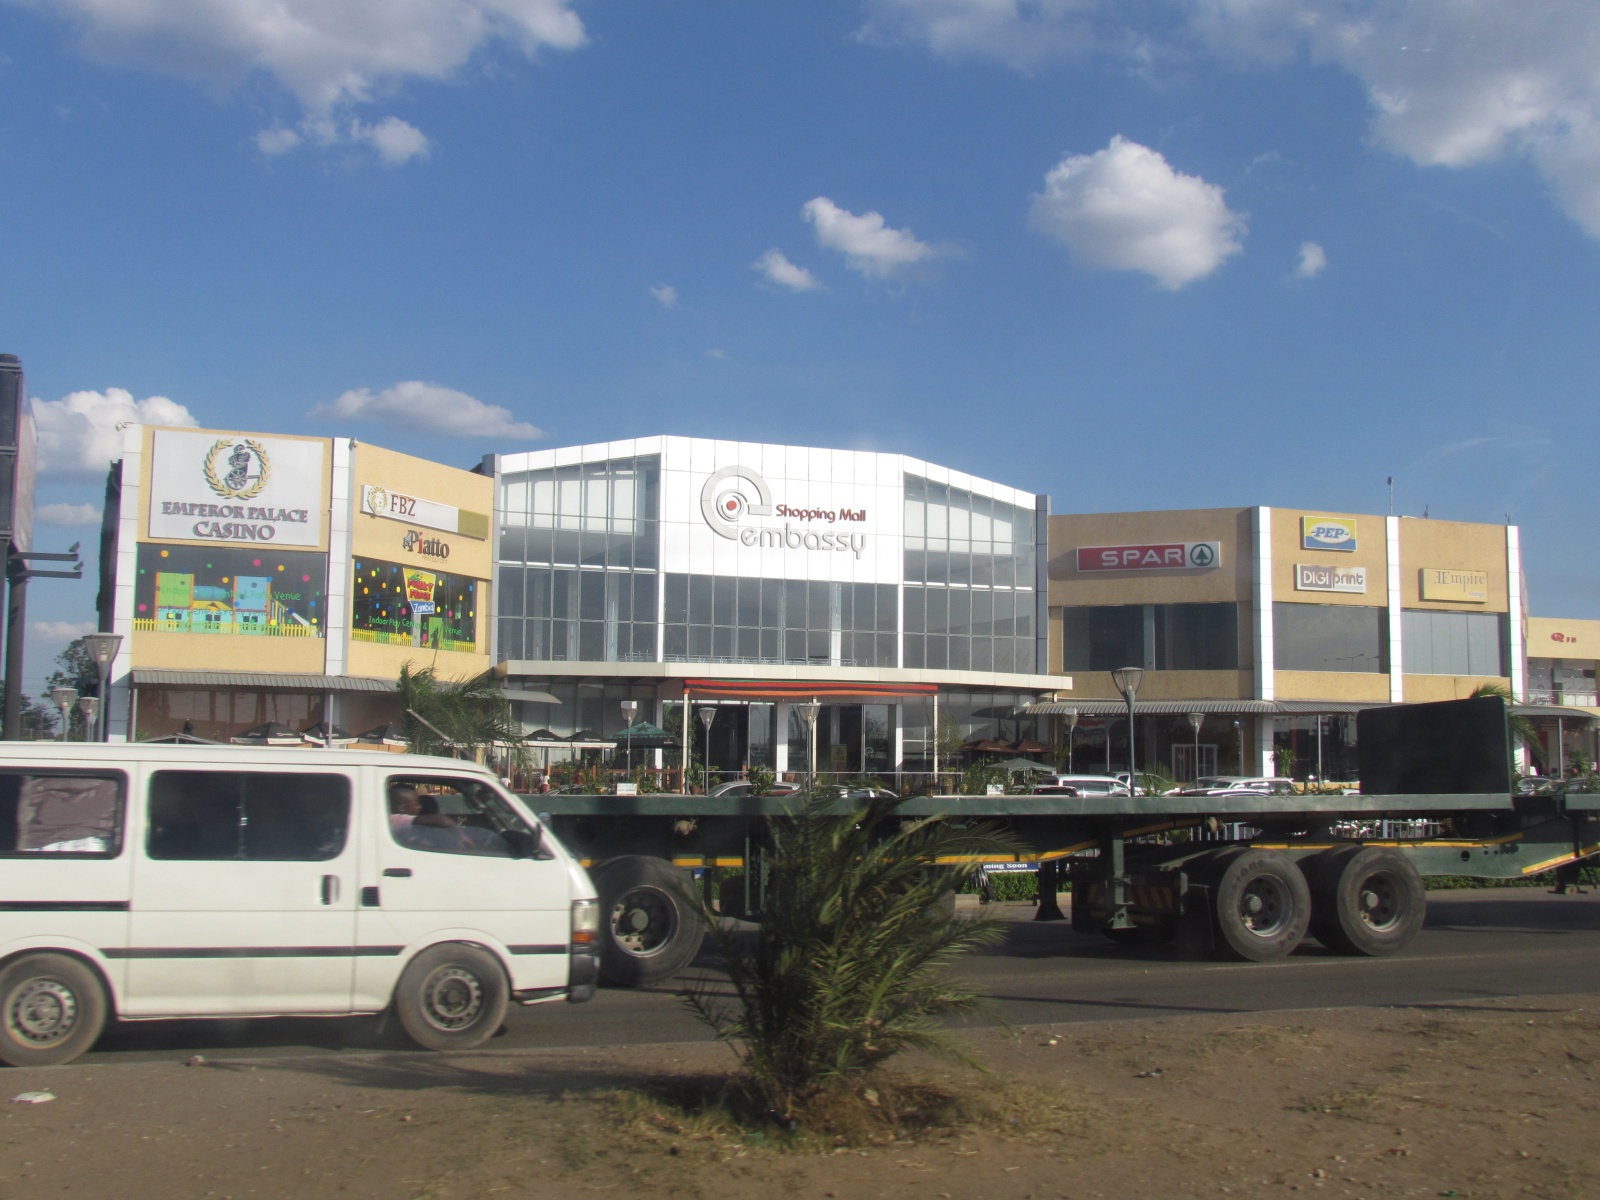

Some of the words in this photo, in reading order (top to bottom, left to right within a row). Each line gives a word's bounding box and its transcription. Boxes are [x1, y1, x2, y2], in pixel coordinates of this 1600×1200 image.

[162, 501, 245, 519] EMPEROR
[247, 506, 308, 523] PALACE
[390, 495, 416, 516] FBZ
[776, 504, 836, 523] Shopping
[839, 508, 866, 522] Mall
[193, 521, 275, 540] CASINO
[408, 530, 450, 559] Piatto
[741, 522, 866, 560] embassy
[1101, 548, 1183, 566] SPAR
[274, 591, 301, 601] Venue
[413, 603, 435, 612] Zambia
